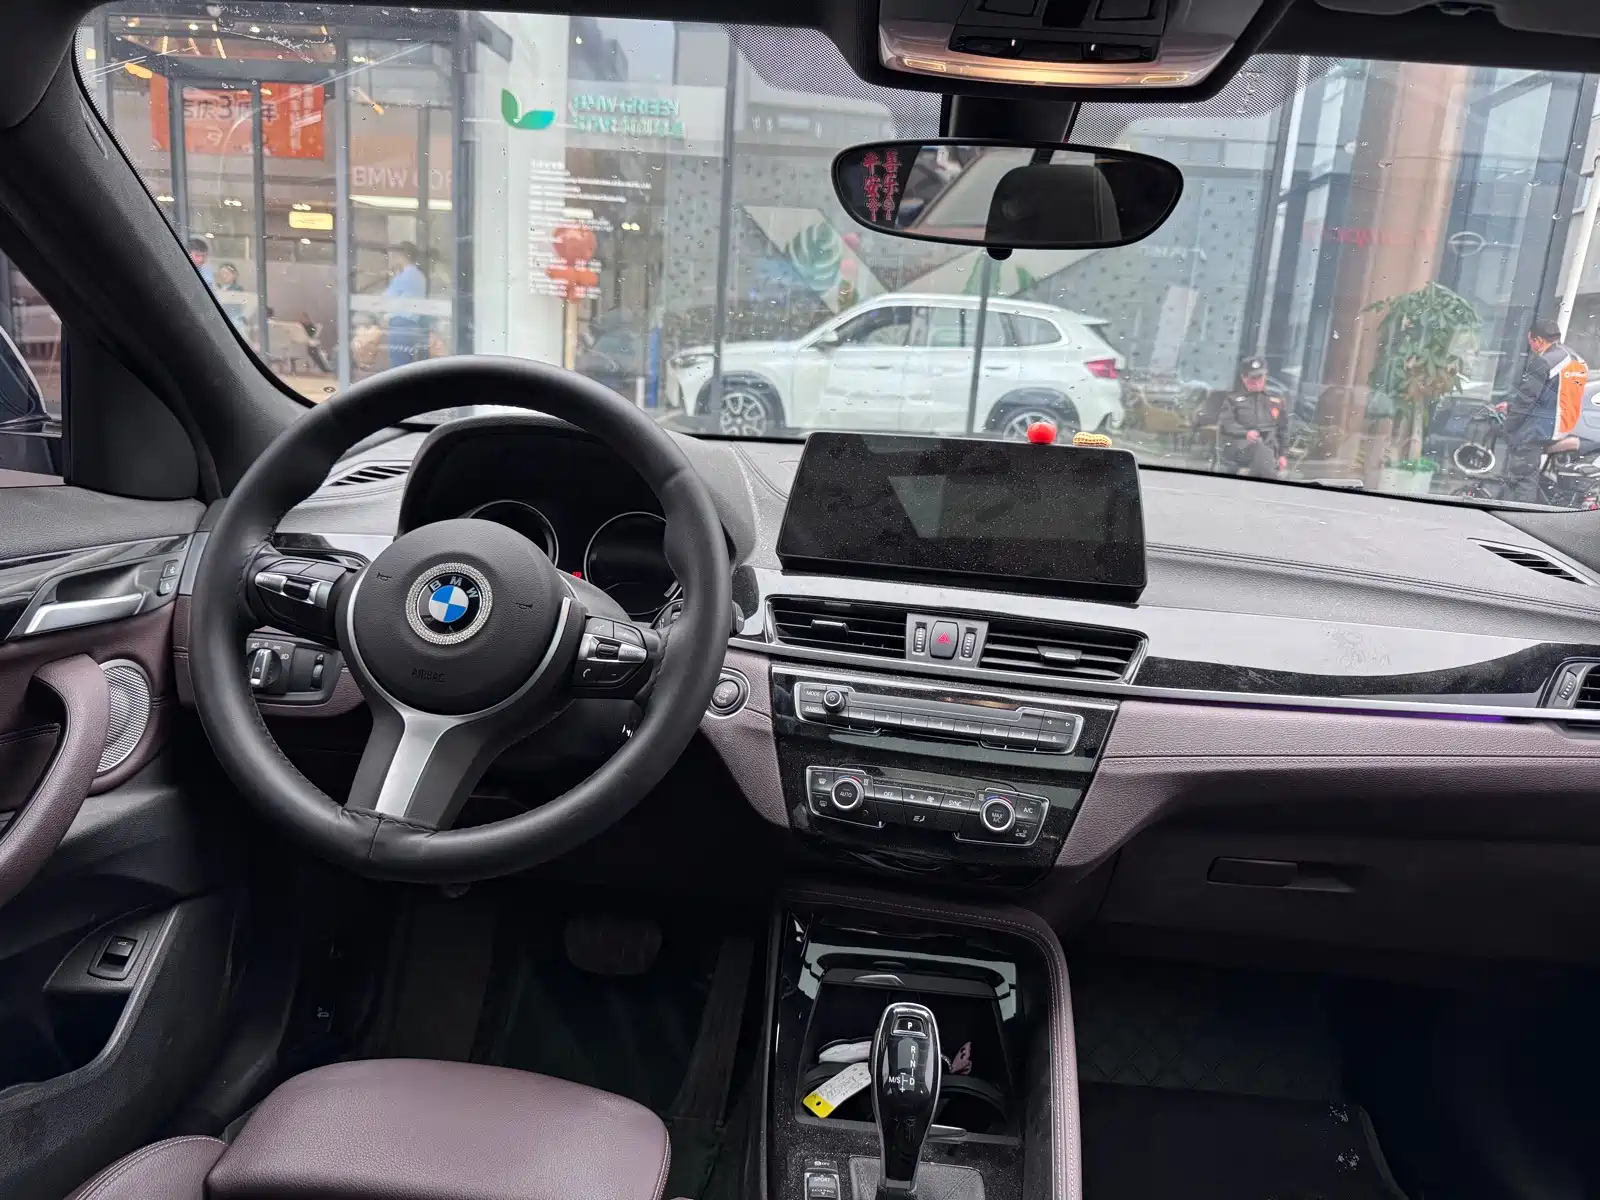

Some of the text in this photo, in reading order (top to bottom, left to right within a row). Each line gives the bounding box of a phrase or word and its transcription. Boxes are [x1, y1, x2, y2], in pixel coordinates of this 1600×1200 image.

[351, 165, 408, 189] BMW
[429, 576, 479, 599] BMW
[840, 790, 853, 798] AUTO
[907, 1021, 913, 1030] P
[910, 1045, 916, 1053] R
[910, 1059, 916, 1068] N
[888, 1076, 901, 1084] M/S
[909, 1077, 915, 1086] D
